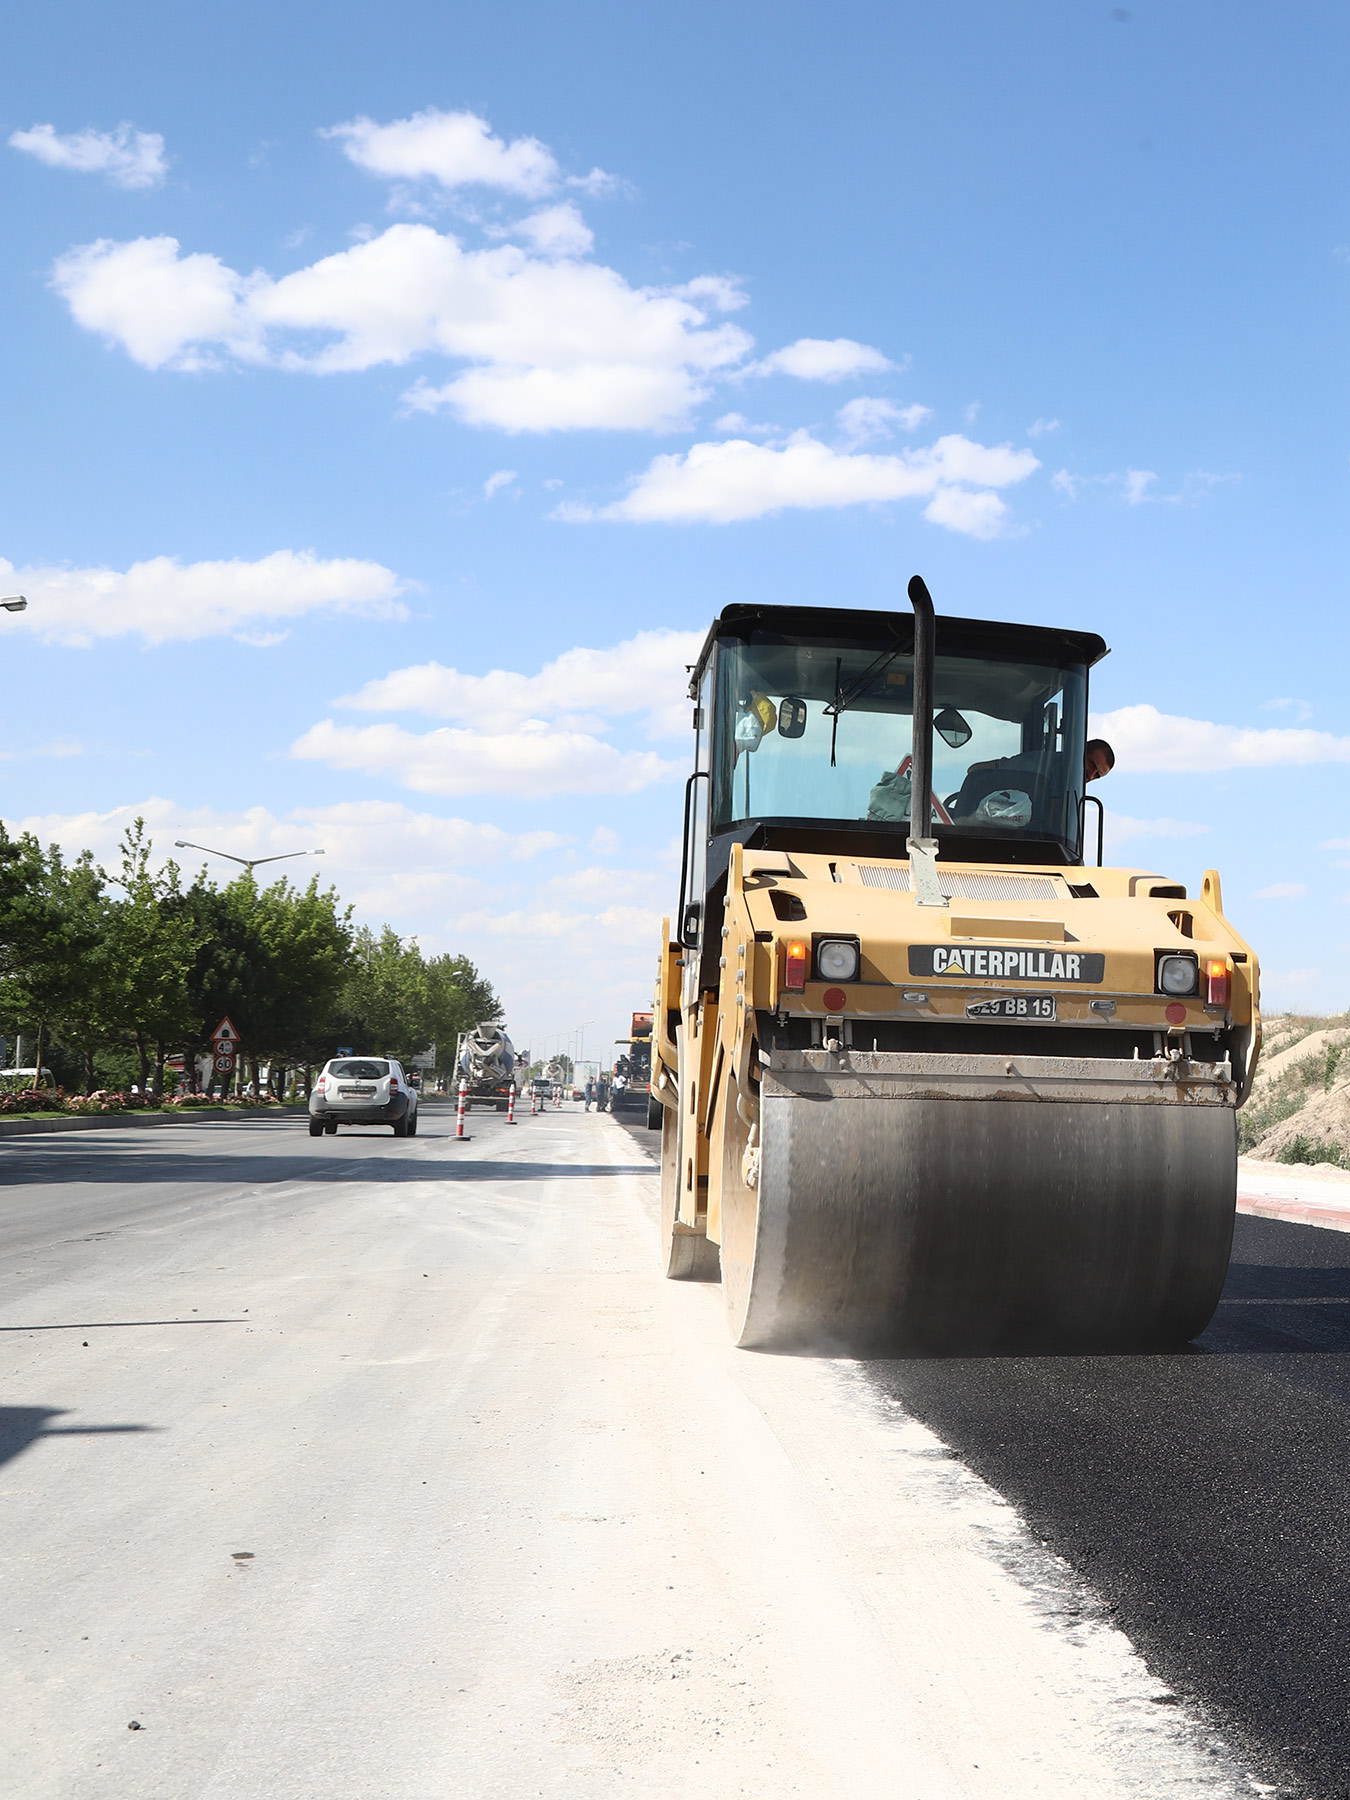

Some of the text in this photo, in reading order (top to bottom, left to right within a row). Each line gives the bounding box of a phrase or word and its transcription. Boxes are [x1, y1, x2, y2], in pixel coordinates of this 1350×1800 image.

[932, 947, 1081, 979] CATERPILLAR
[1005, 998, 1027, 1015] BB
[1032, 998, 1051, 1016] 15
[217, 1059, 231, 1068] 60
